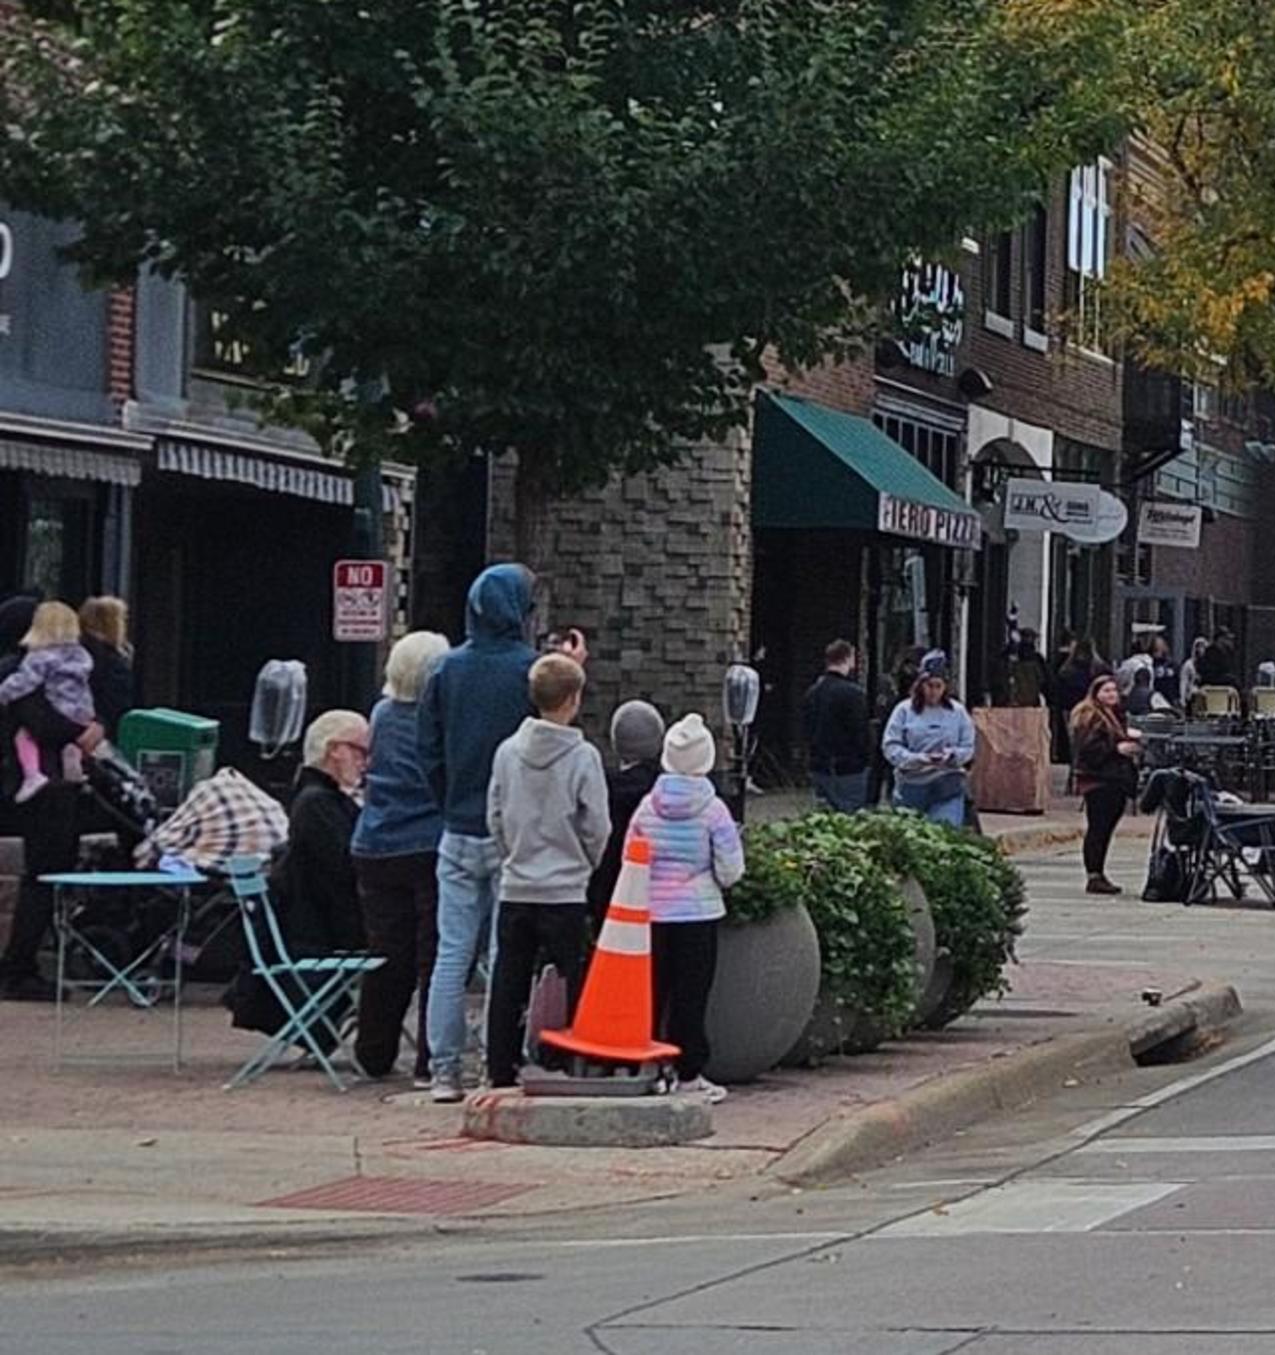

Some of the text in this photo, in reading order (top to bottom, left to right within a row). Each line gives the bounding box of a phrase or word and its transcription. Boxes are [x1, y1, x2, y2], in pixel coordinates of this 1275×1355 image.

[883, 496, 931, 534] FIERO
[1040, 492, 1067, 524] &
[347, 566, 373, 585] NO
